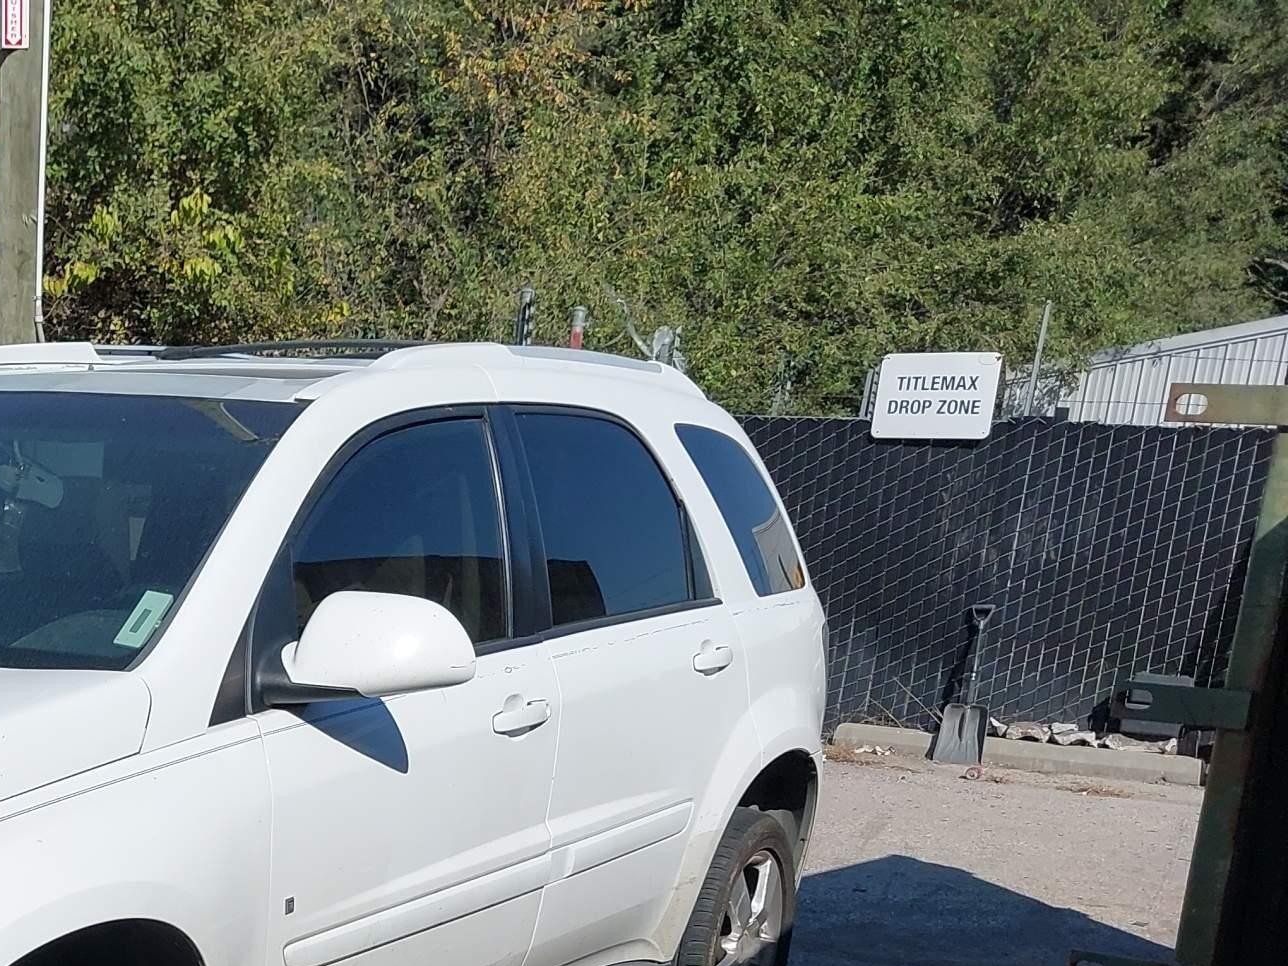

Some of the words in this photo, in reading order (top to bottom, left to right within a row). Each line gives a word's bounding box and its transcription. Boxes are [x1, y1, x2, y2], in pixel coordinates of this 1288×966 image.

[897, 375, 980, 391] TITLEMAX
[887, 399, 932, 415] DROP
[936, 399, 981, 415] ZONE
